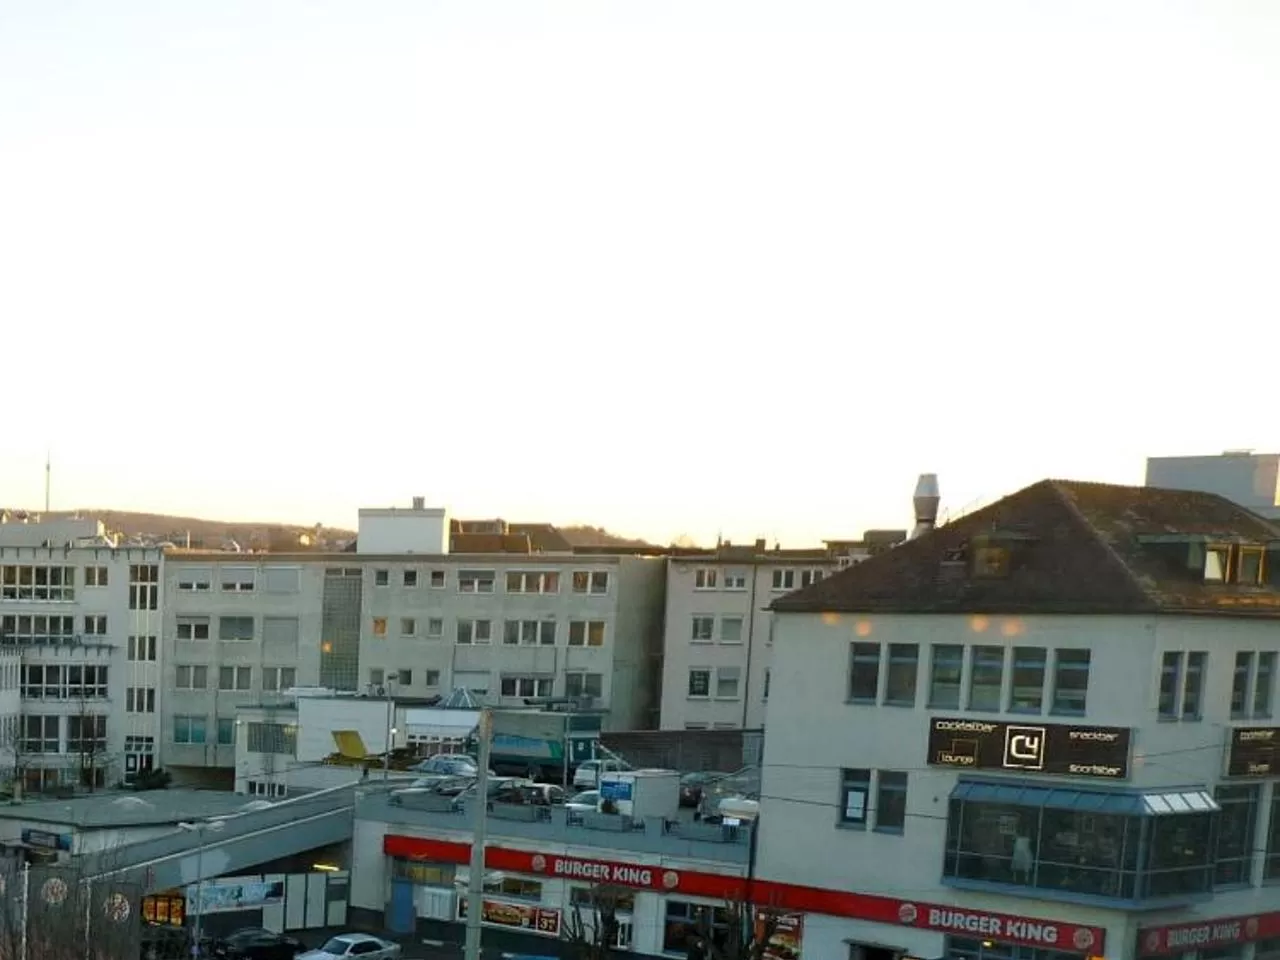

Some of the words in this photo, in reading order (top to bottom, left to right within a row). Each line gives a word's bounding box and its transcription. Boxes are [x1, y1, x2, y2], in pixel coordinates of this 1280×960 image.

[554, 859, 610, 879] BURGER
[613, 866, 651, 885] KING
[929, 909, 1001, 935] BURGER
[1006, 922, 1058, 943] KING
[1167, 926, 1210, 947] BURGER
[1212, 920, 1241, 941] KING
